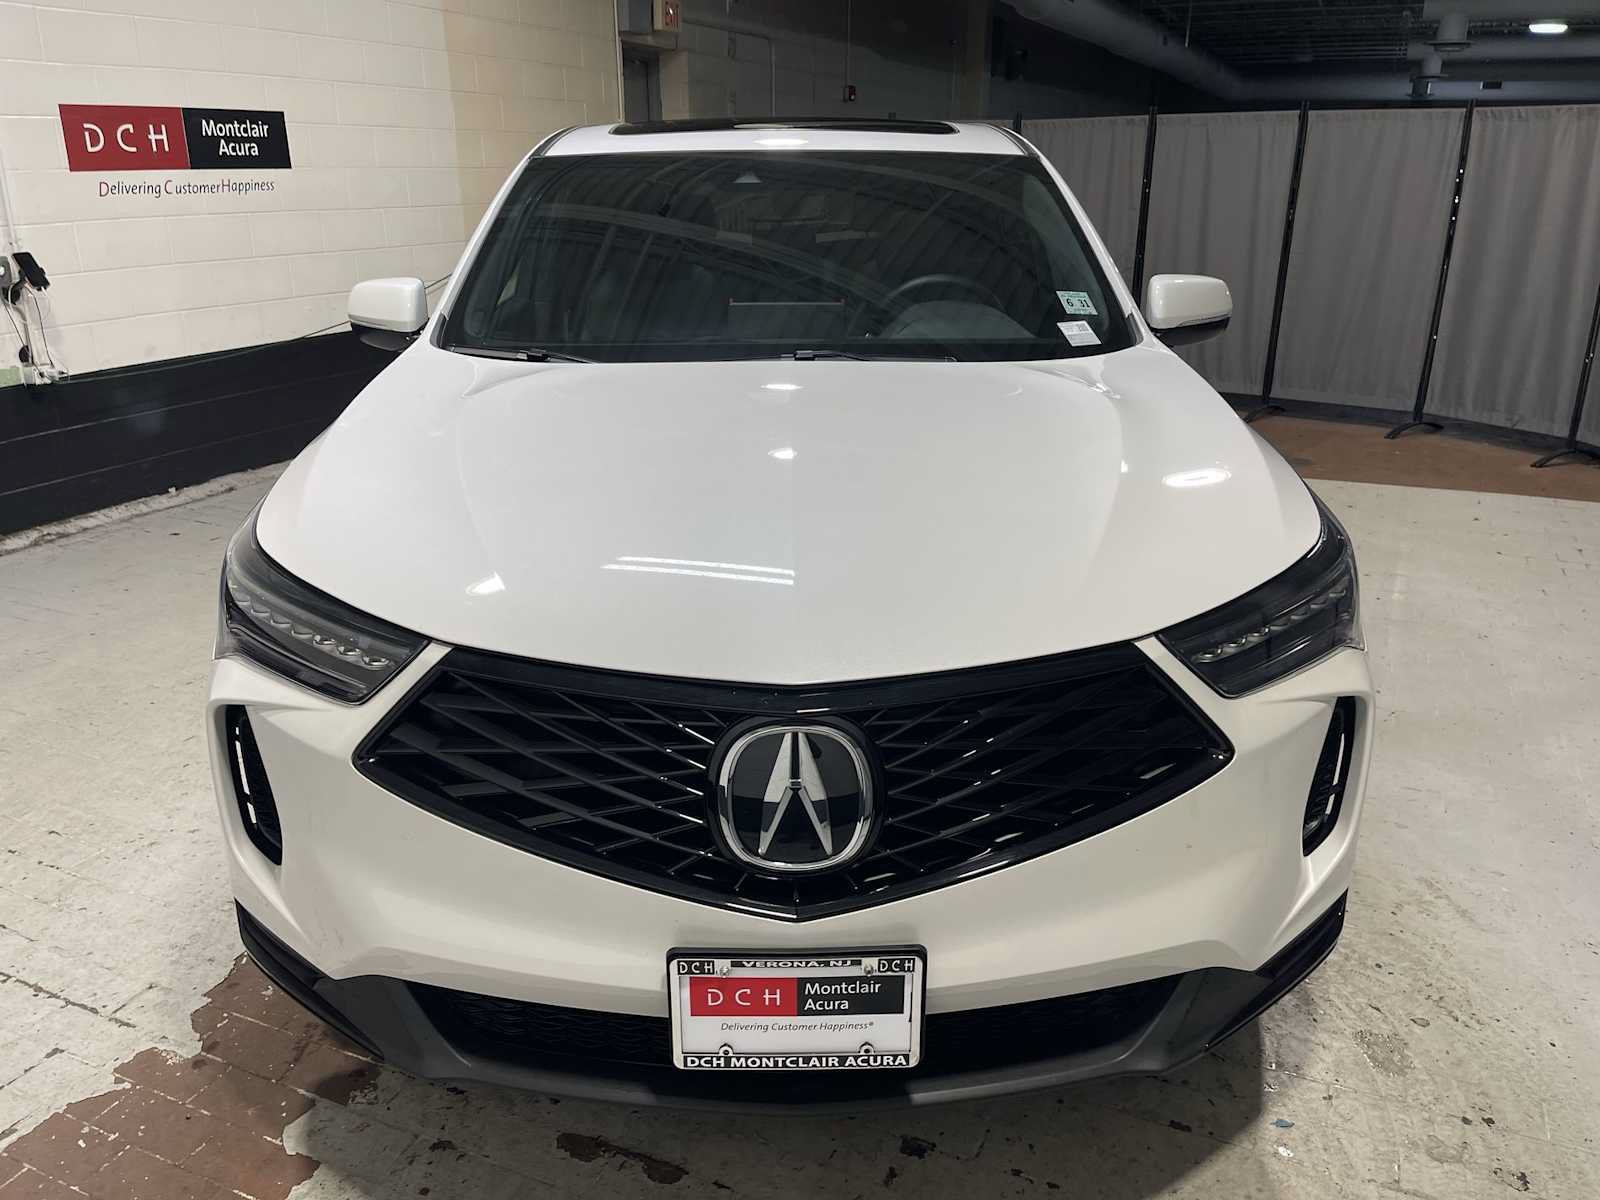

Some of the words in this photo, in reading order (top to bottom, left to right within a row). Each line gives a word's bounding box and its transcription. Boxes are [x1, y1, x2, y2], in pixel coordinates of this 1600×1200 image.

[201, 119, 269, 138] Montclair
[218, 139, 259, 156] Acura
[99, 181, 161, 198] Delivering
[804, 981, 881, 995] Montclair
[804, 999, 849, 1010] Acura
[720, 1022, 769, 1032] Delivering
[771, 1022, 817, 1031] Customer
[686, 1057, 725, 1068] DCH
[730, 1056, 839, 1068] MONTCLAIR
[844, 1055, 907, 1067] ACURA
